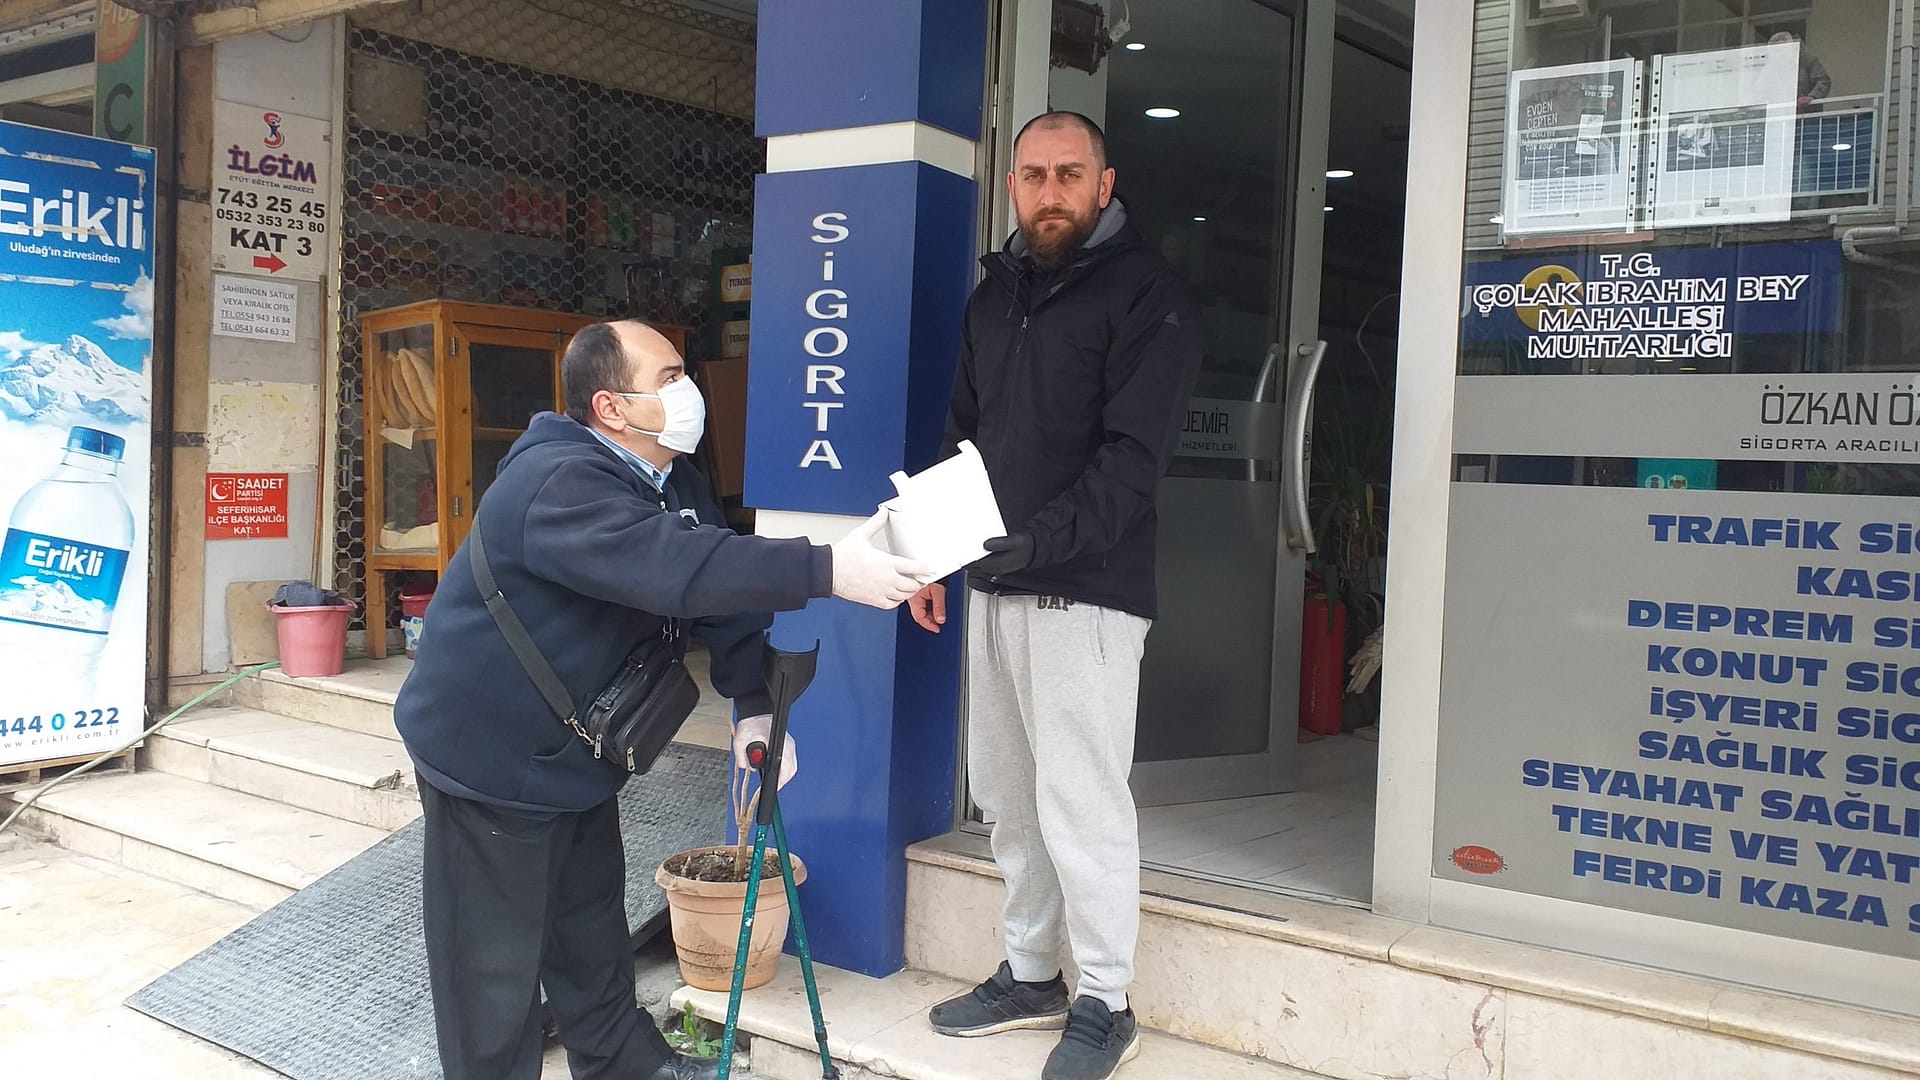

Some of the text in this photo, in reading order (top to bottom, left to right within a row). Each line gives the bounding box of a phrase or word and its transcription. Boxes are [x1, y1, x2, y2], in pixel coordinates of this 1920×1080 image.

[1526, 100, 1553, 118] EVDEN
[227, 144, 317, 185] İLGİM
[0, 180, 144, 250] Erikli
[217, 187, 326, 219] 743 25 45
[216, 208, 325, 233] 0532 353 23 80
[62, 248, 121, 264] zirvesinden
[230, 227, 312, 257] KAT 3
[1599, 252, 1661, 278] T.C.
[223, 297, 243, 306] VEYA
[1473, 281, 1584, 313] ÇOLAK
[1736, 274, 1810, 302] BEY
[1761, 384, 1920, 426] ÖZKAN Ö
[1740, 434, 1827, 450] SİGORTA
[237, 478, 284, 489] SAADET
[230, 514, 285, 525] BAŞKANLIĞI
[255, 526, 260, 535] 1
[24, 538, 105, 577] Erikli
[1627, 599, 1854, 644] DEPREM
[1646, 644, 1828, 688] KONUT
[0, 706, 120, 737] 444 0 222
[1637, 729, 1828, 780] SAĞLIK
[1521, 758, 1744, 813] SEYAHAT
[1551, 803, 1920, 884] TEKNE VE YAT
[1739, 875, 1890, 929] KAZA
